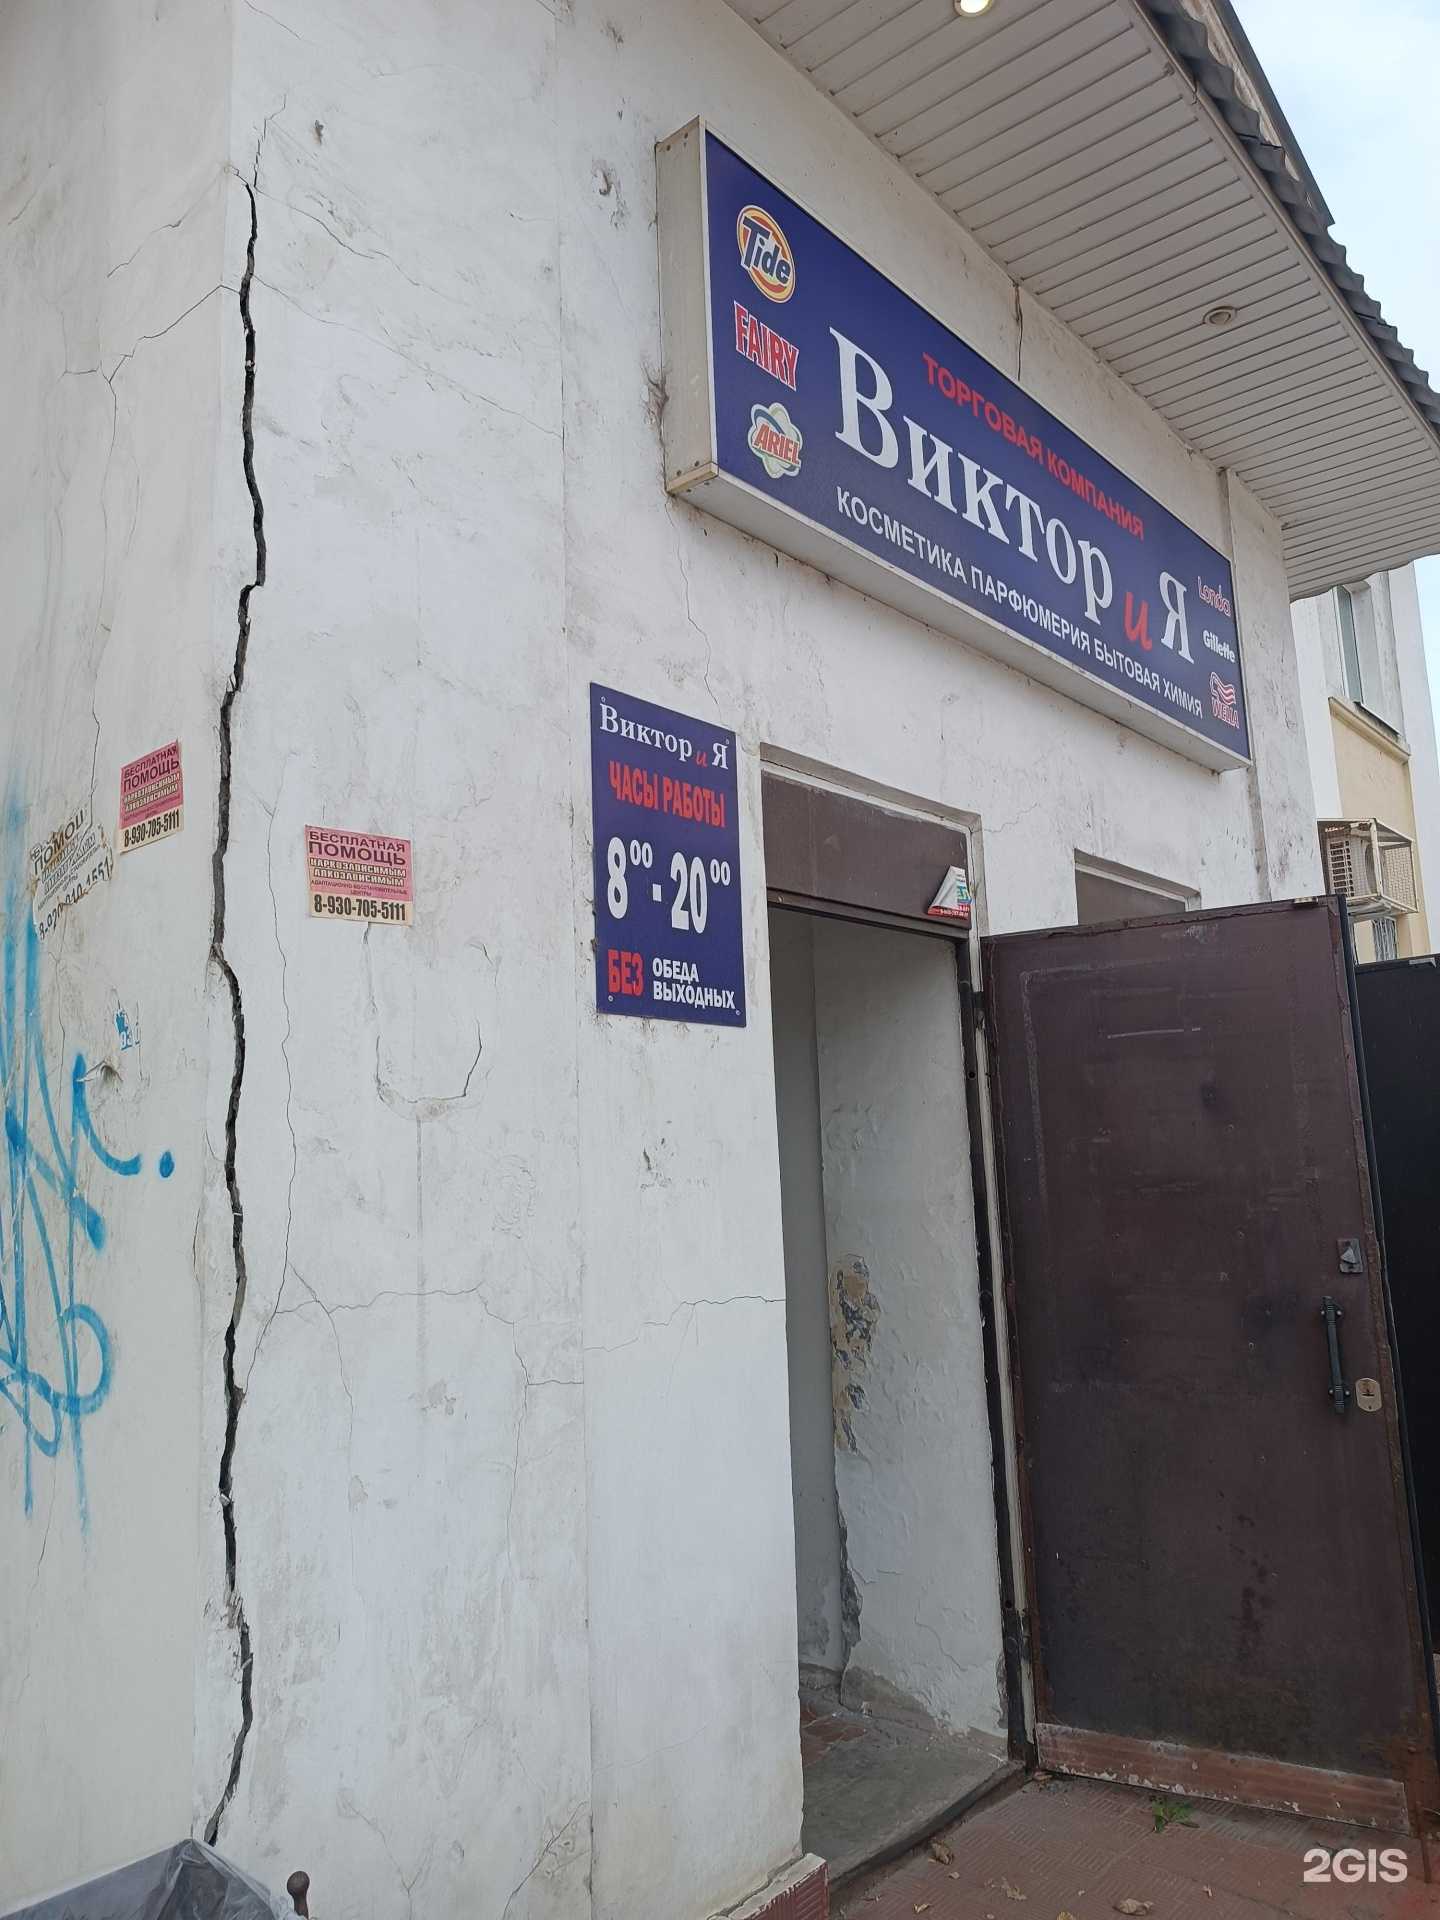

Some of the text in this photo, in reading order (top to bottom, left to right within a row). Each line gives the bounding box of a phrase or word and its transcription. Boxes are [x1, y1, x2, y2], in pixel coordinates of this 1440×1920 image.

[741, 215, 791, 285] Tide
[734, 300, 799, 391] FAIRY
[753, 423, 801, 465] ARIEL
[922, 352, 1144, 541] ТОРГОВАЯ КОМПАНИЯ
[829, 327, 1195, 664] Виктор и Я
[836, 486, 1203, 720] КОСМЕТИКА ПАРФЮМЕРИЯ БЫТОВАЯ ХИМИЯ
[1198, 576, 1232, 627] Londa
[1202, 630, 1236, 663] Gillette
[1212, 697, 1240, 729] WELLA
[599, 703, 693, 762] Виктор
[711, 742, 729, 770] Я
[123, 758, 180, 793] ПОМОЩЬ
[124, 745, 178, 779] БЕСПЛАТНАЯ
[609, 760, 726, 828] ЧАСЫ РАБОТЫ
[124, 809, 180, 848] 8-930-705-5111
[309, 831, 406, 853] БЕСПЛАТНАЯ
[309, 841, 406, 867] ПОМОЩЬ
[314, 894, 406, 921] 8-930-705-5111
[607, 949, 699, 996] БЕЗ ОБЕДА
[653, 981, 736, 1009] ВЫХОДНЫХ
